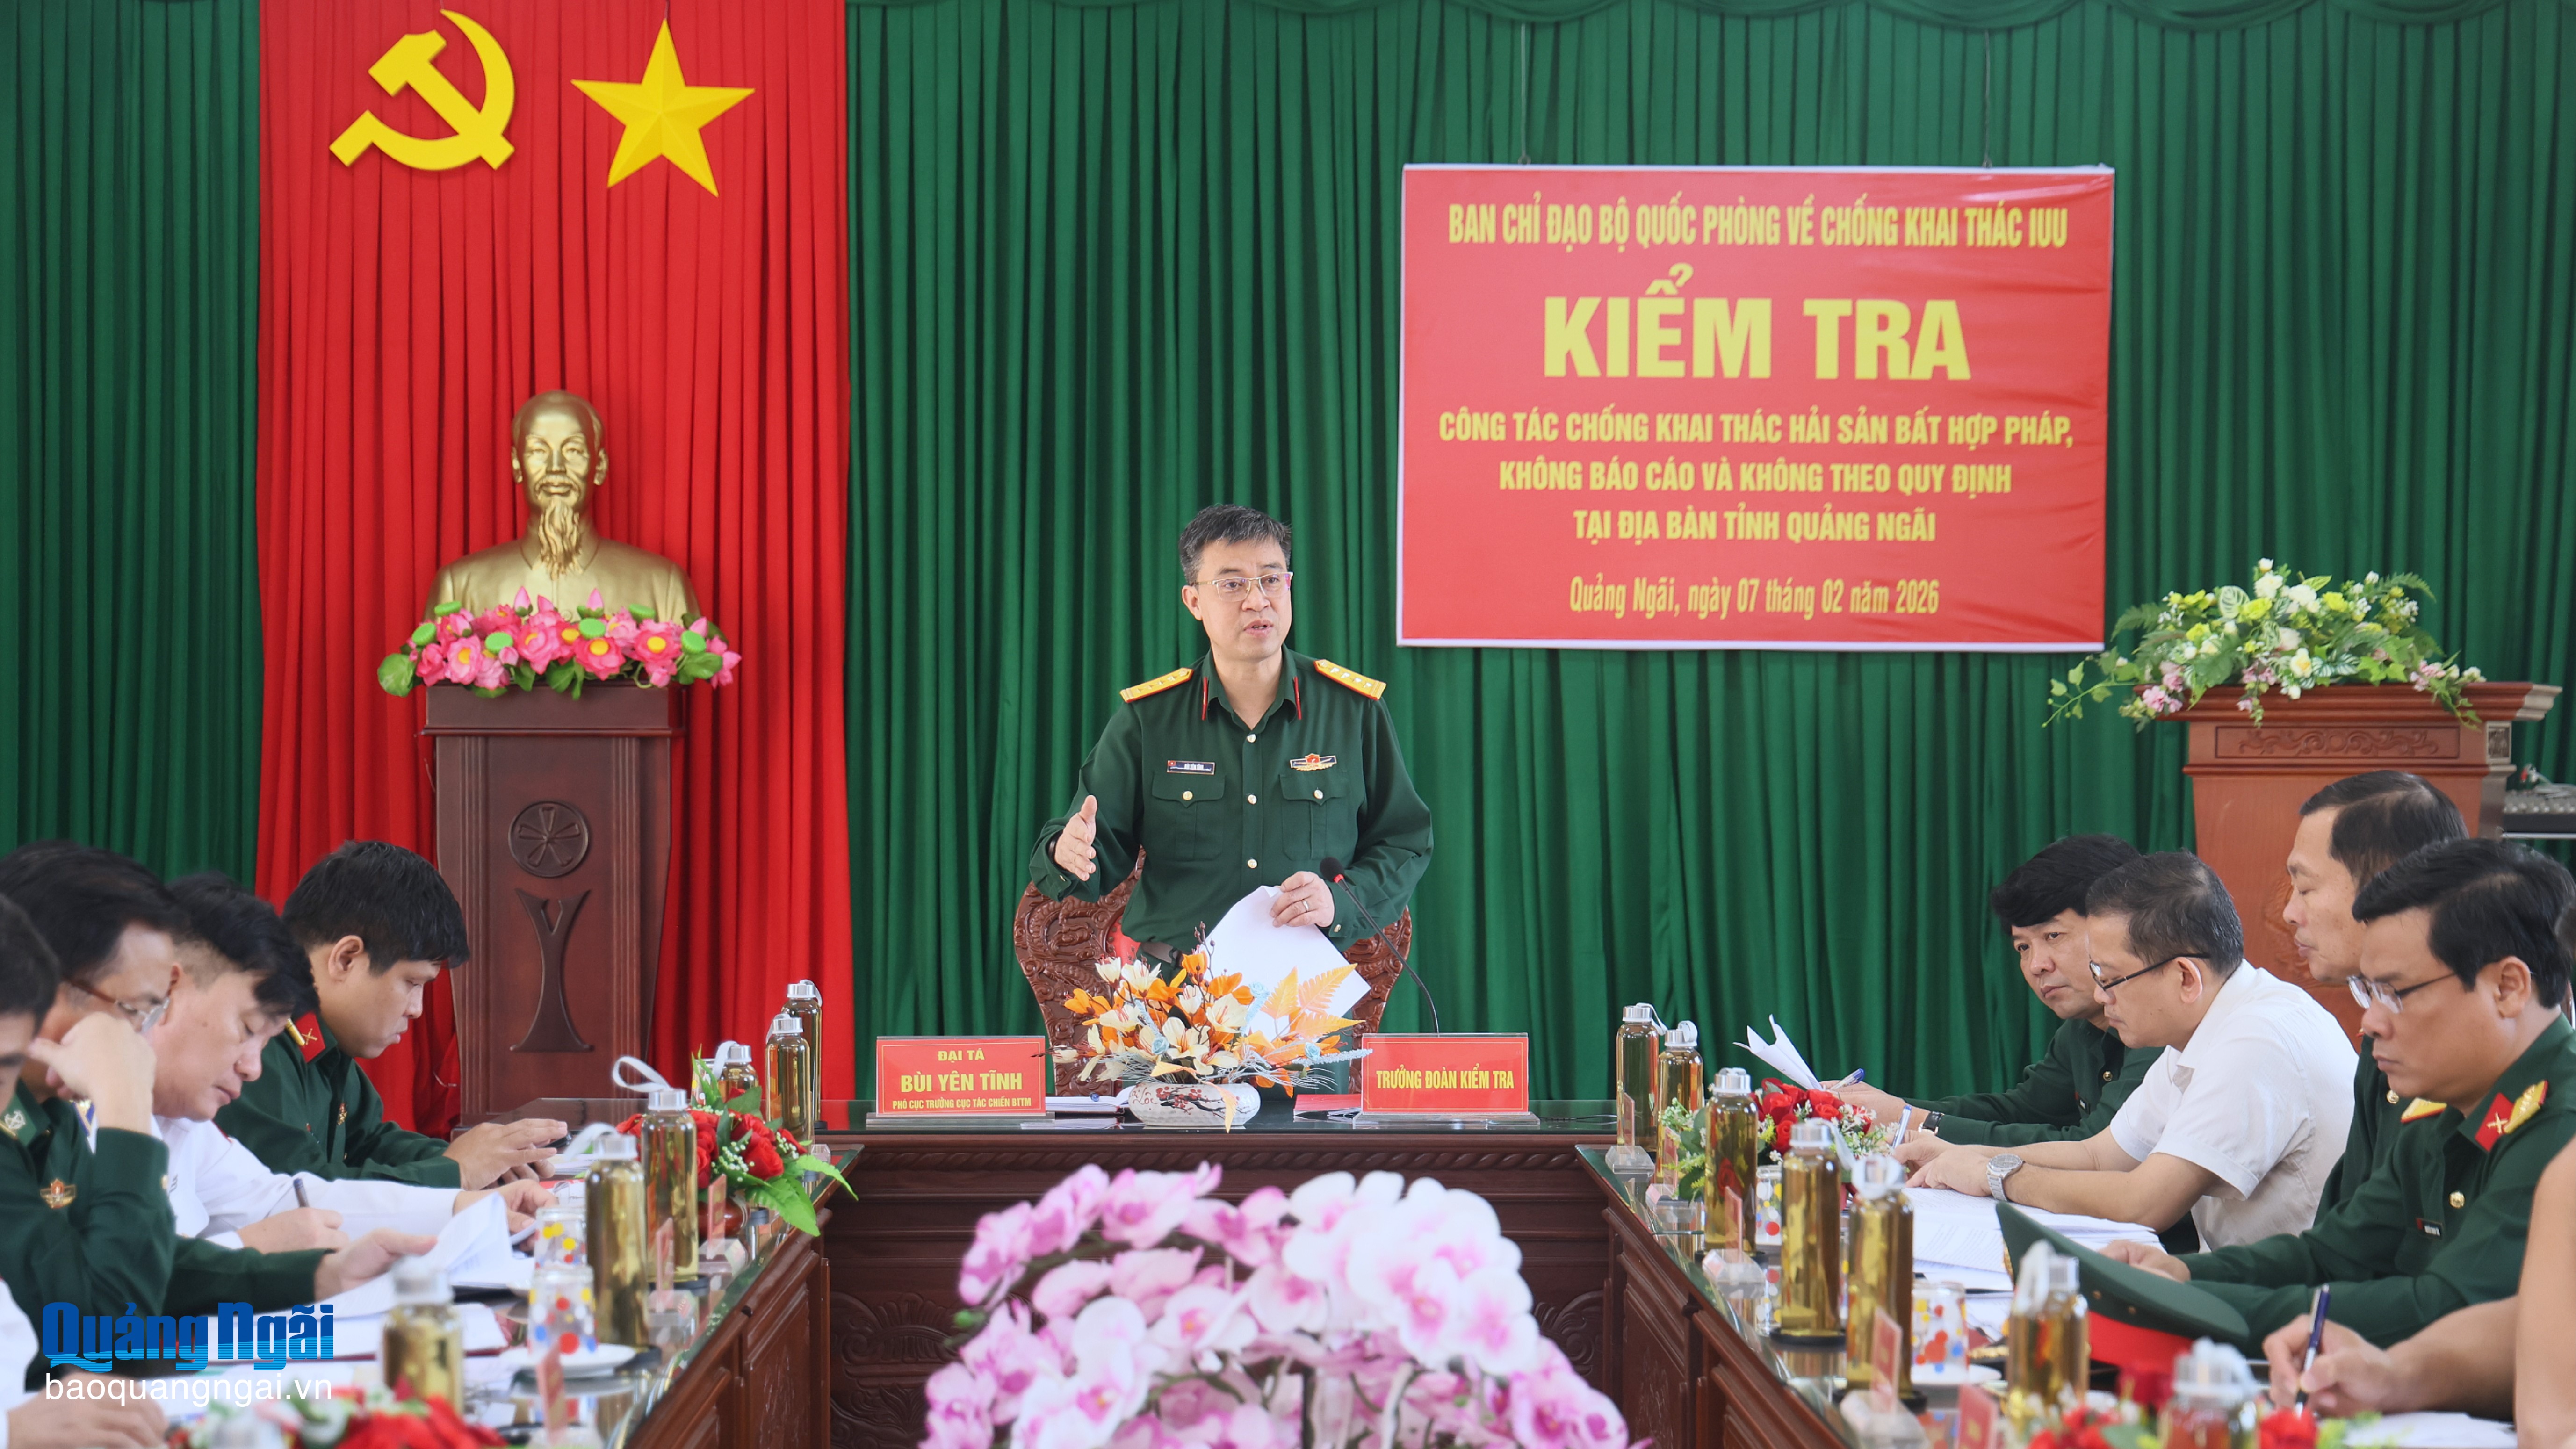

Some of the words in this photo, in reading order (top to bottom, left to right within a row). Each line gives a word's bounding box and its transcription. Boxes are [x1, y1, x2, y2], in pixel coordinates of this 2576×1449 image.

[1449, 204, 1495, 243] BAN
[1502, 190, 1541, 244] CHỈ
[1546, 205, 1592, 252] ĐẠO
[1599, 197, 1629, 252] BỘ
[1637, 191, 1696, 247] QUỐC
[1703, 196, 1780, 245] PHÒNG
[1787, 194, 1814, 245] VỀ
[1821, 193, 1899, 246] CHỐNG
[1905, 207, 1958, 247] KHAI
[1965, 200, 2023, 247] THÁC
[2029, 207, 2068, 248] IUU
[1544, 263, 1771, 379] KIỂM
[1803, 298, 1971, 380] TRA
[1439, 407, 1506, 441] CÔNG
[1512, 407, 1559, 442] TÁC
[1566, 404, 1649, 442] CHỐNG
[1656, 414, 1713, 442] KHAI
[1719, 409, 1782, 443] THÁC
[1789, 405, 1830, 443] HẢI
[1837, 405, 1888, 444] SẢN
[1895, 405, 1942, 444] BẤT
[1948, 413, 1998, 451] HỢP
[2004, 411, 2073, 449] PHÁP,
[1500, 456, 1583, 490] KHÔNG
[1589, 456, 1639, 491] BÁO
[1645, 456, 1695, 491] CÁO
[1702, 457, 1733, 491] VÀ
[1740, 457, 1824, 492] KHÔNG
[1829, 463, 1891, 493] THEO
[1898, 463, 1946, 496] QUY
[1951, 464, 2012, 499] ĐỊNH
[1573, 510, 1611, 545] TẠI
[1617, 511, 1660, 545] ĐỊA
[1666, 505, 1717, 540] BÀN
[1723, 502, 1780, 540] TỈNH
[1786, 503, 1870, 543] QUẢNG
[1876, 507, 1936, 541] NGÃI
[1569, 573, 1626, 619] Quảng
[1632, 577, 1680, 619] Ngãi,
[1688, 577, 1732, 620] ngày
[1737, 578, 1760, 612] 07
[1765, 578, 1815, 620] tháng
[1821, 579, 1844, 613] 02
[1850, 581, 1889, 613] năm
[1895, 579, 1940, 614] 2026
[938, 1050, 963, 1063] ĐẠI
[967, 1048, 985, 1060] TÁ
[1376, 1064, 1422, 1089] TRƯỞNG
[1425, 1066, 1457, 1089] ĐOÀN
[1460, 1063, 1490, 1089] KIỂM
[1493, 1070, 1515, 1089] TRA
[892, 1098, 909, 1110] PHÓ
[909, 1099, 924, 1110] CỤC
[926, 1097, 954, 1109] TRƯỞNG
[956, 1099, 971, 1110] CỤC
[973, 1097, 986, 1108] TÁC
[988, 1096, 1010, 1107] CHIẾN
[1011, 1097, 1032, 1107] BTTM
[901, 1070, 932, 1093] BÙI
[938, 1070, 974, 1092] YÊN
[979, 1070, 1023, 1091] TĨNH
